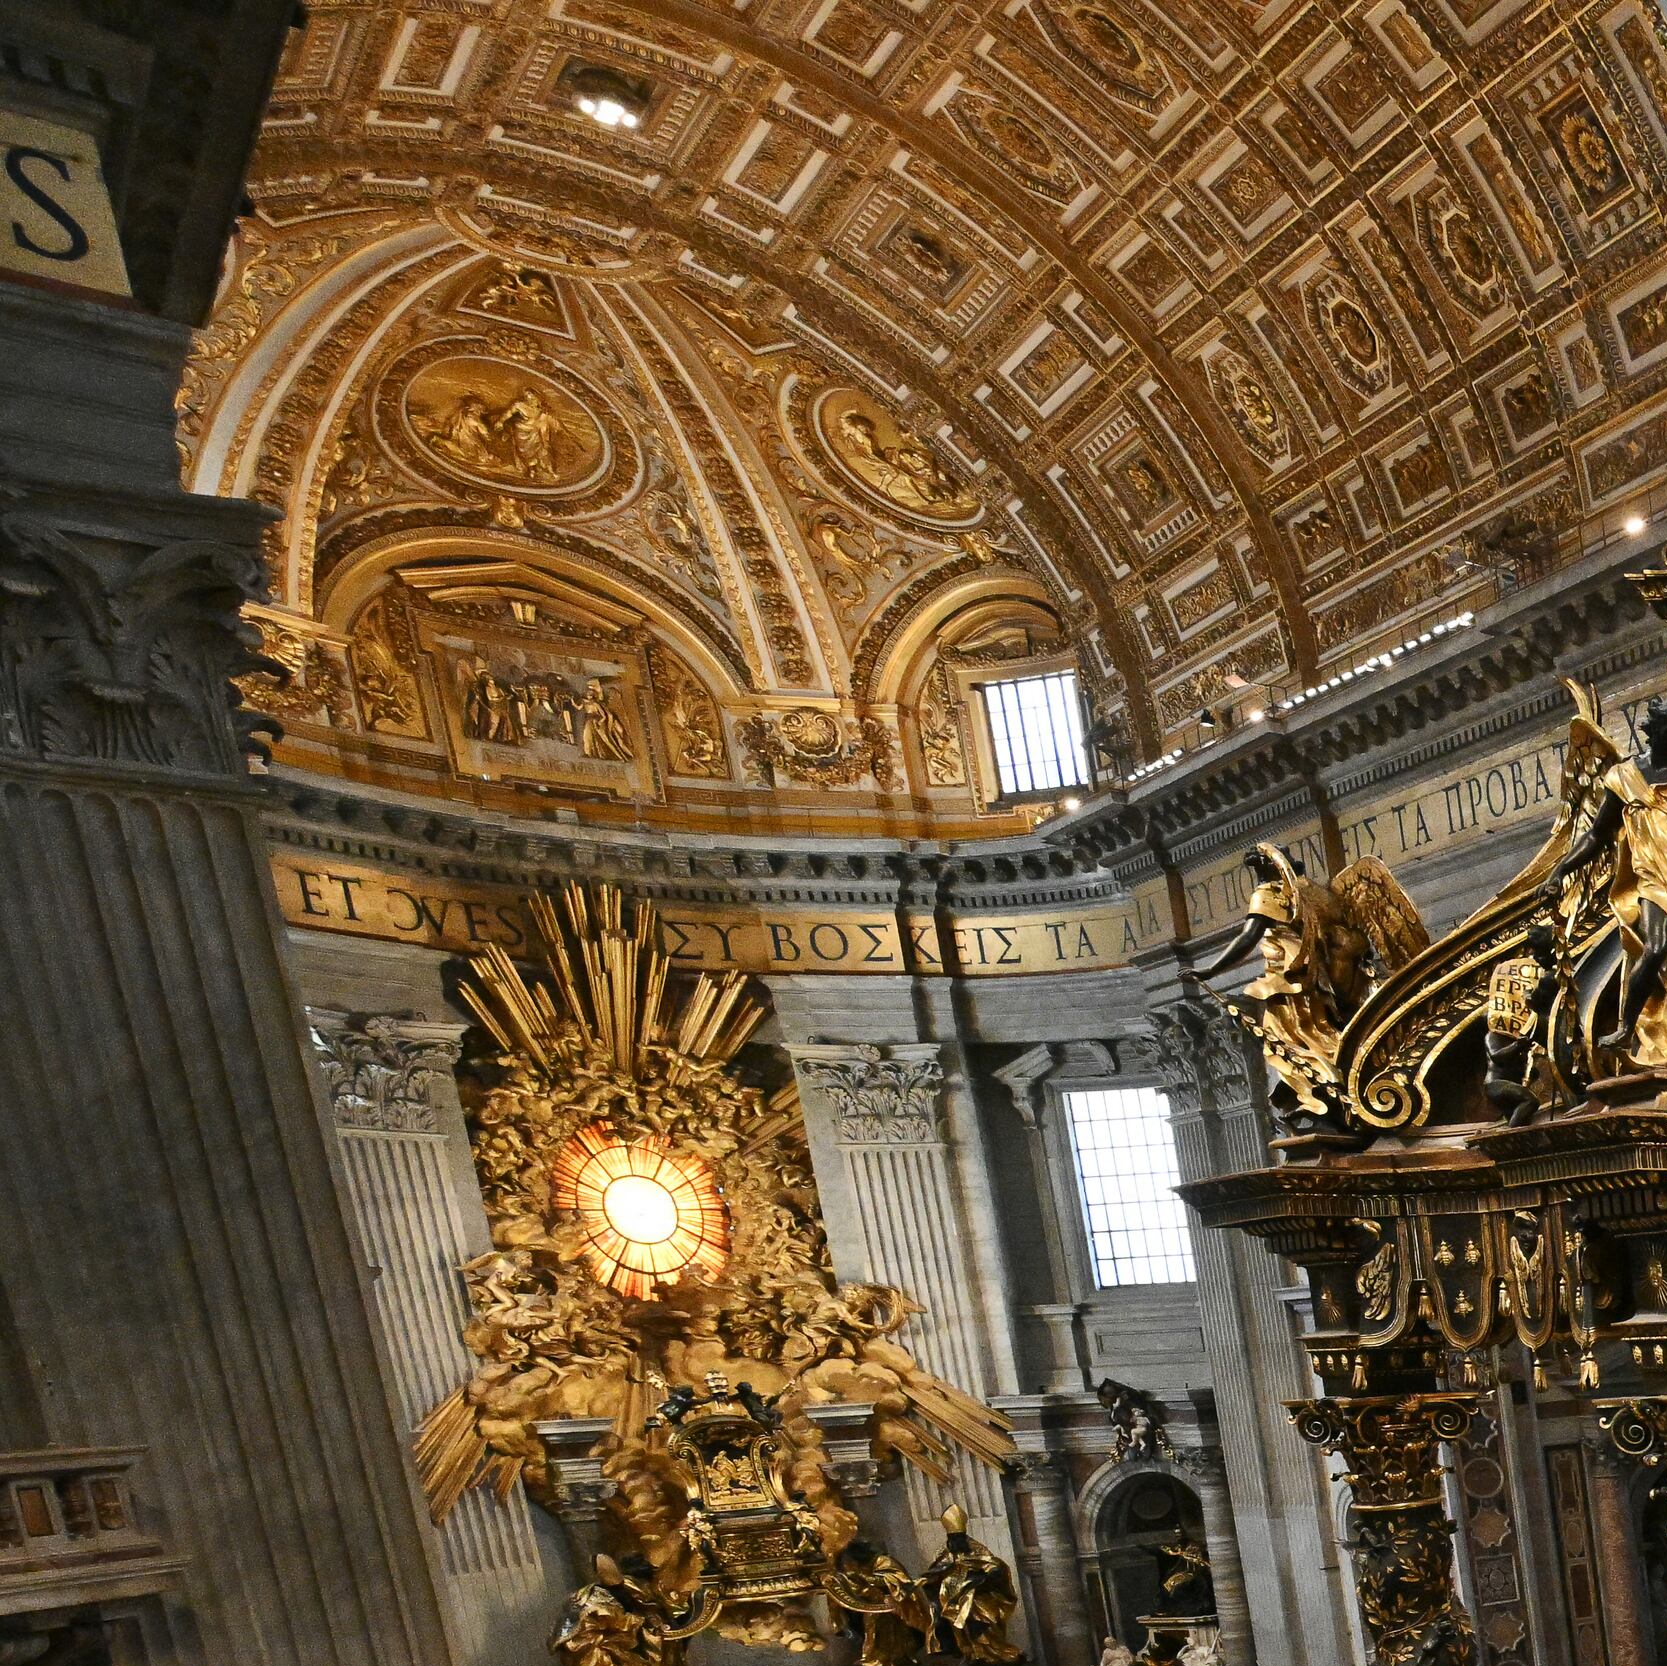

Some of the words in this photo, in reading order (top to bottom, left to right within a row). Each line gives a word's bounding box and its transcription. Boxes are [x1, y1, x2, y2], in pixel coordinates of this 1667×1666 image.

[298, 869, 362, 922] ET
[664, 921, 742, 962] ΣΥ
[1044, 921, 1098, 960] ΤΑ
[1392, 801, 1433, 852] ΤΑ
